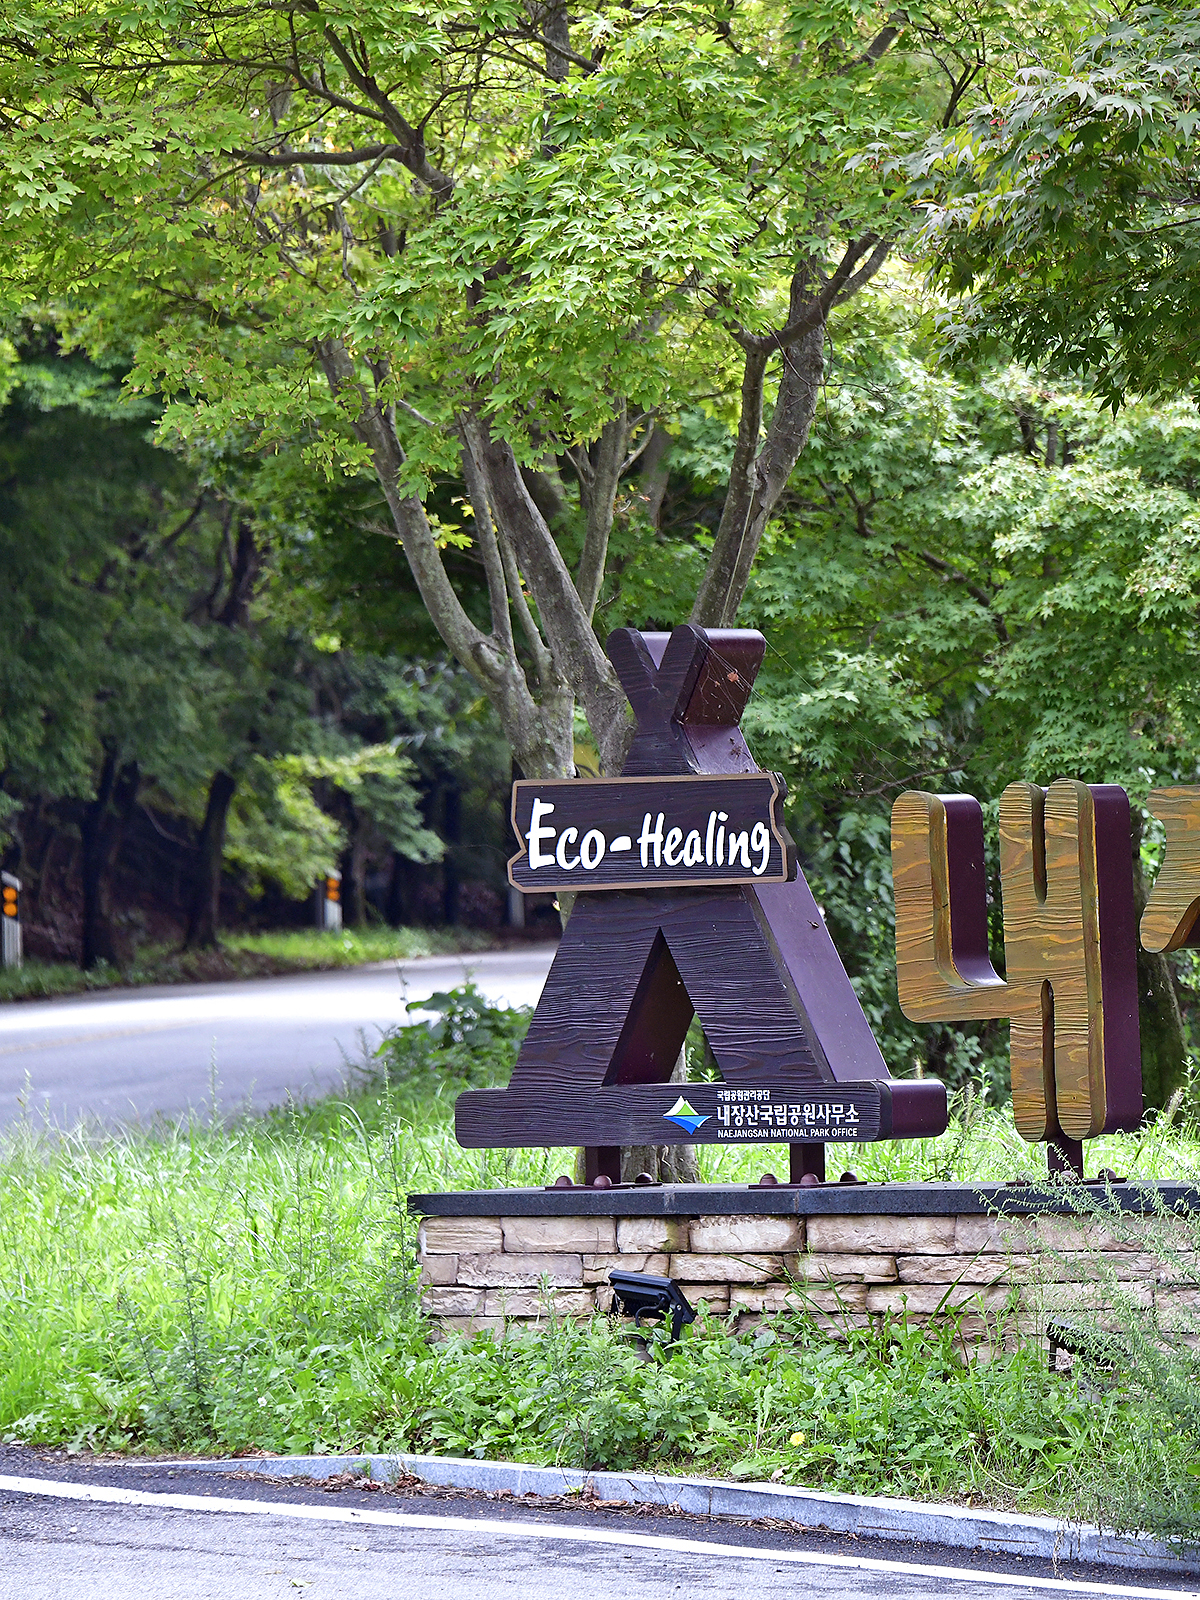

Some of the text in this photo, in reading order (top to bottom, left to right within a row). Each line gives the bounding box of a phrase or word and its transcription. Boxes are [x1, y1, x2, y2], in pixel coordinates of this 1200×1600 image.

[525, 798, 770, 876] Eco-Healing
[717, 1089, 770, 1101] 국립공원관리공단
[717, 1103, 860, 1127] 내장산국립공원사무소
[717, 1127, 858, 1138] NAEJANGSAN NATIONAL PARK OFFICE
